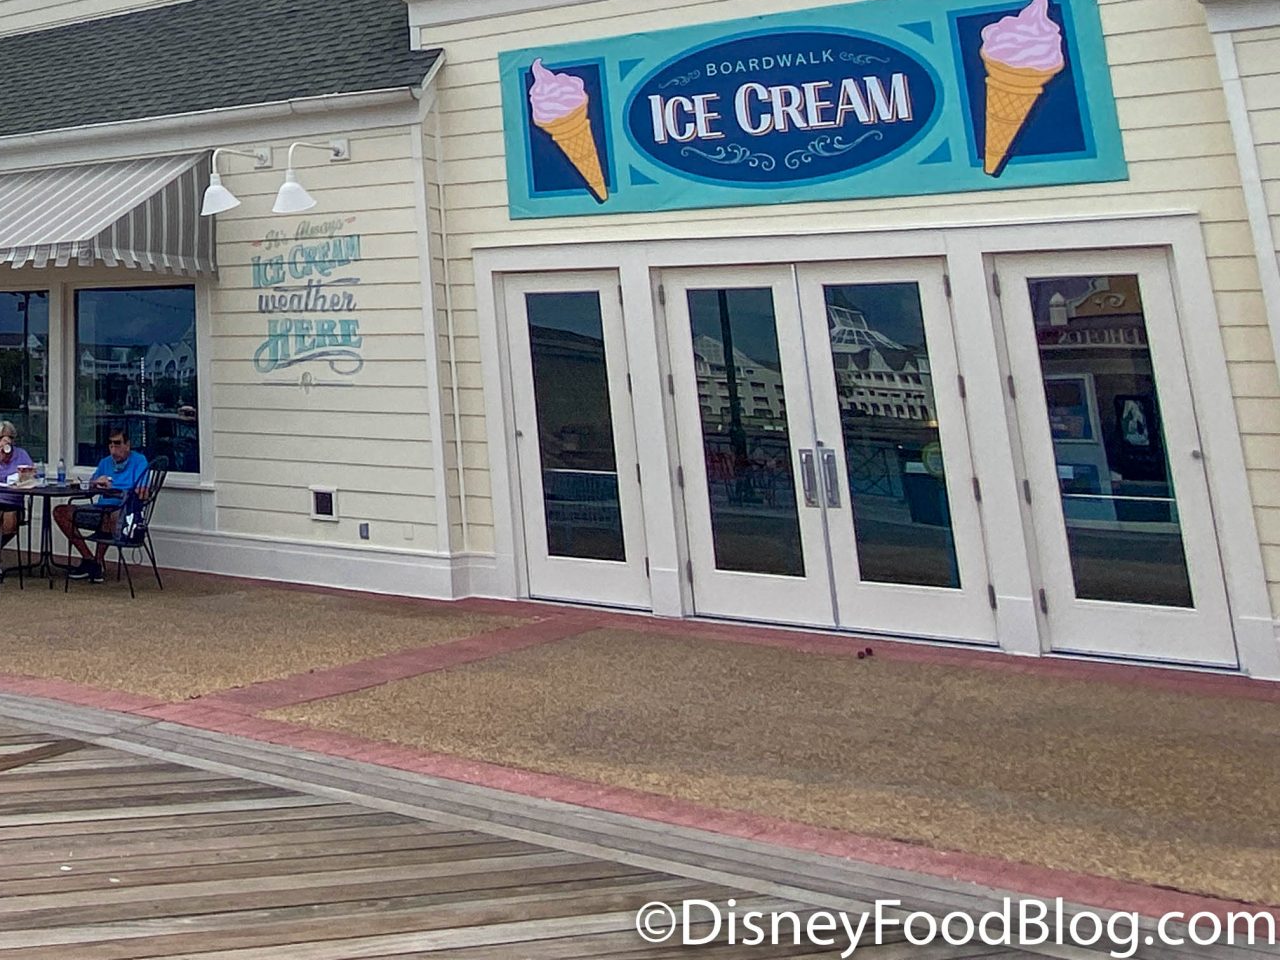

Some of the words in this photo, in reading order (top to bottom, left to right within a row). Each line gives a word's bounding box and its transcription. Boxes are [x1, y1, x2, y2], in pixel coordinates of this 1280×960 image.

[706, 49, 834, 77] BOARDWALK
[648, 93, 726, 145] ICE
[734, 72, 914, 137] CREAM
[251, 254, 287, 289] ICE
[288, 233, 361, 280] CREAM
[258, 278, 360, 314] weather
[254, 318, 363, 373] HERE
